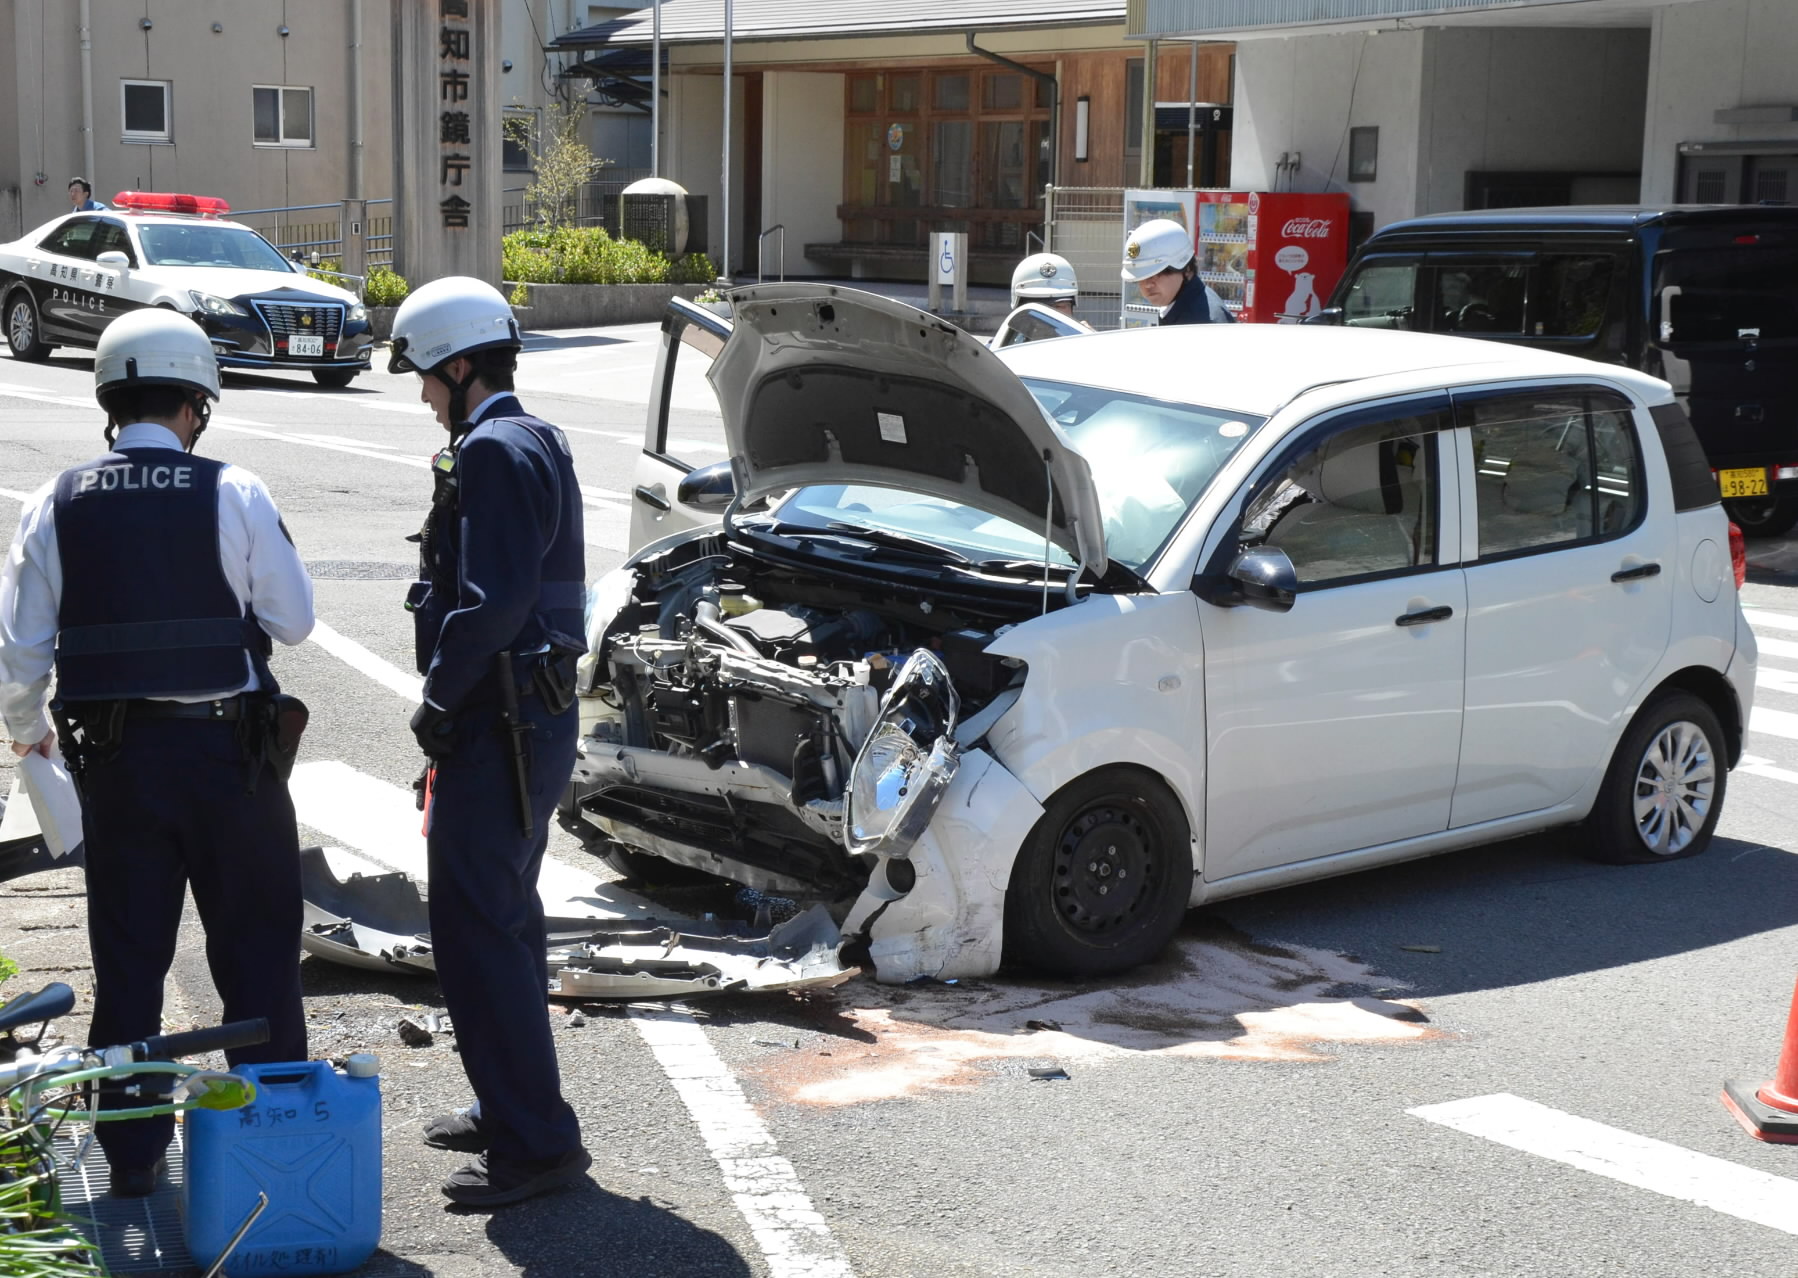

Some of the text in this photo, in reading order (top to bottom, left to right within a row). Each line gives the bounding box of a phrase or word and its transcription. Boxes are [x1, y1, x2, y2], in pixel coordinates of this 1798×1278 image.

[53, 288, 105, 312] POLICE
[80, 466, 192, 493] POLICE
[1730, 479, 1766, 496] 98-22
[239, 1101, 330, 1128] 高知 5
